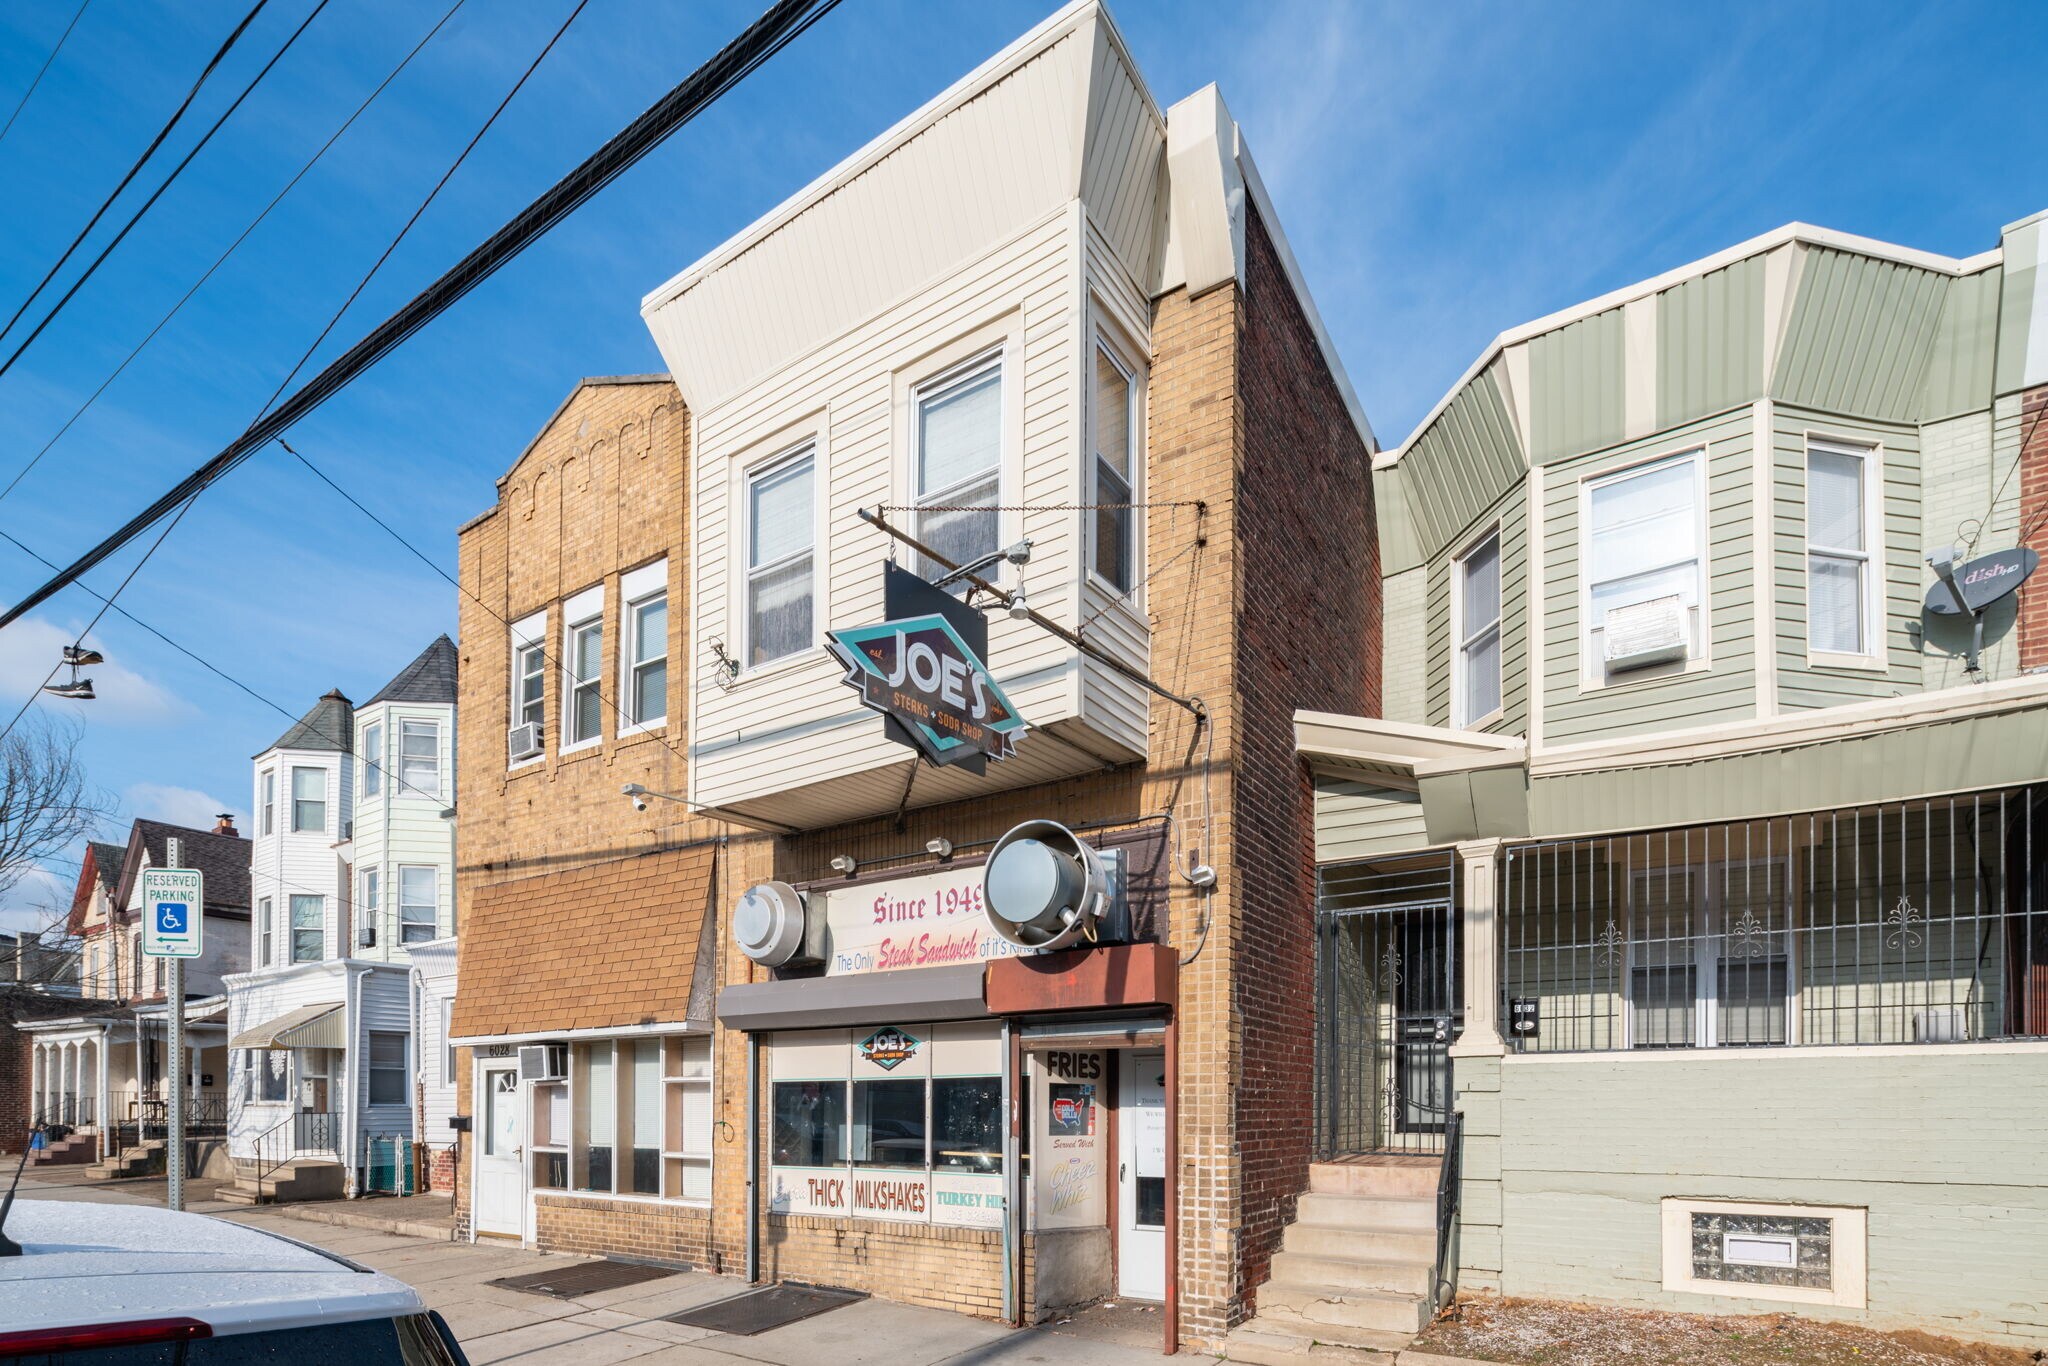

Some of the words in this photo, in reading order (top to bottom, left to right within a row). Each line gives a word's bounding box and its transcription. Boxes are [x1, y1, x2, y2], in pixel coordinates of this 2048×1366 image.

[888, 628, 987, 720] JOE'S
[893, 691, 929, 719] STEAKS
[937, 711, 960, 732] SODA
[962, 720, 983, 741] SHOP
[146, 874, 197, 887] RESERVED
[149, 889, 194, 902] PARKING
[873, 891, 927, 925] Since
[837, 953, 853, 972] The
[854, 951, 874, 973] Only
[877, 937, 915, 969] Steak
[916, 928, 978, 965] Sandwich
[979, 938, 991, 957] of
[992, 937, 1007, 956] it's
[1047, 1051, 1101, 1079] FRIES
[1053, 1139, 1076, 1149] Served
[1078, 1139, 1094, 1148] With
[1049, 1161, 1098, 1189] Cheez
[808, 1178, 845, 1208] THICK
[854, 1179, 925, 1214] MILKSHAKES
[936, 1191, 982, 1208] TURKEY
[985, 1194, 1003, 1209] HI
